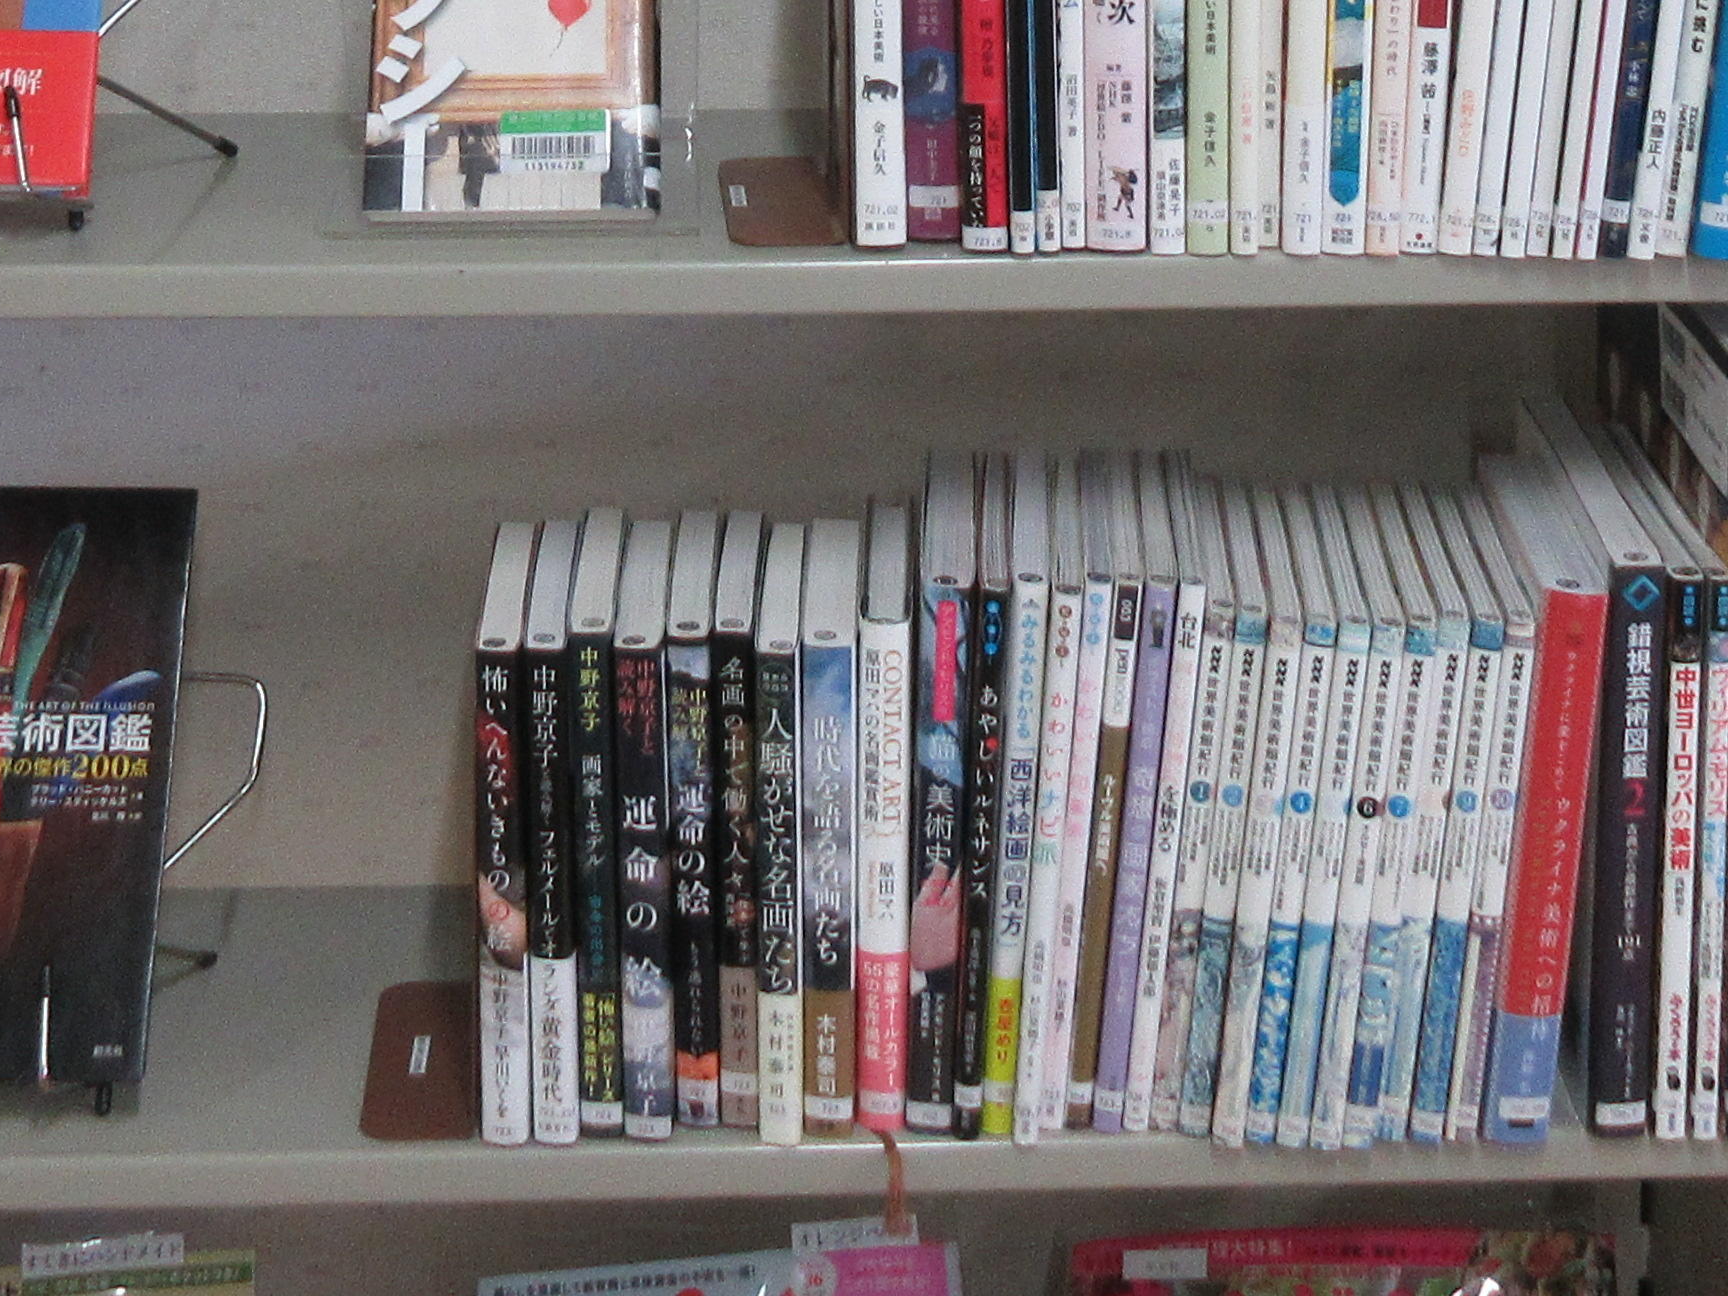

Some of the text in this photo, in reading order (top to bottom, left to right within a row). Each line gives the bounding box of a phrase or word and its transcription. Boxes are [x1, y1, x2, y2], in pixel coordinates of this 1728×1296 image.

[873, 122, 886, 175] 金子信久
[1204, 112, 1217, 166] 金子信久
[1646, 109, 1666, 170] 内藤正人
[532, 665, 559, 768] 中野京子
[1178, 612, 1198, 649] 台北
[482, 665, 511, 949] 怖いへんないきものの絵
[580, 647, 604, 866] 中野京子 画家とモデル
[722, 657, 748, 888] 名画の中で働く人々
[882, 650, 902, 823] CONTACT ART
[972, 685, 998, 896] あやしいルネサンス
[1670, 667, 1697, 870] 中世ヨーロッパの美術
[623, 795, 662, 997] 運命の絵
[678, 783, 709, 915] 運命の絵
[760, 709, 793, 993] 人騒がせな名画たち
[813, 716, 841, 964] 時代を語る名画たち
[878, 862, 894, 920] 原田マハ
[817, 1014, 836, 1096] 木村泰司
